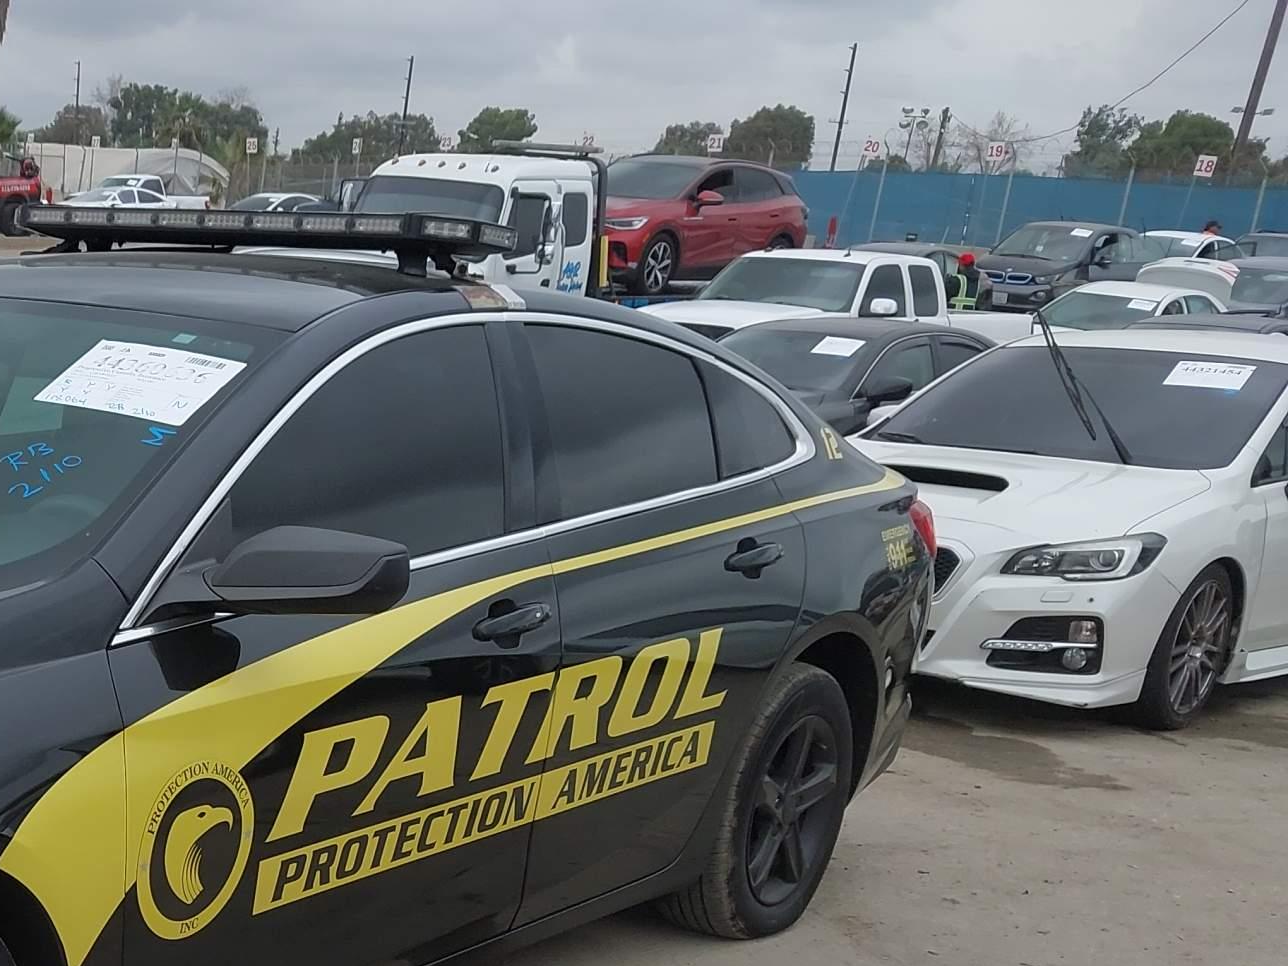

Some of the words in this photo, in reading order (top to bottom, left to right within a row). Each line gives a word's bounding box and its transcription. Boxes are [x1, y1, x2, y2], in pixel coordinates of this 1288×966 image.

[709, 137, 721, 149] 21
[864, 140, 880, 152] 20
[988, 145, 1003, 157] 19
[1196, 159, 1215, 173] 18
[265, 628, 728, 842] PATROL
[147, 761, 210, 836] PROTECTION
[211, 762, 249, 809] AMERICA
[270, 783, 537, 903] PROTECTION
[552, 729, 699, 809] AMERICA
[179, 917, 199, 935] INC
